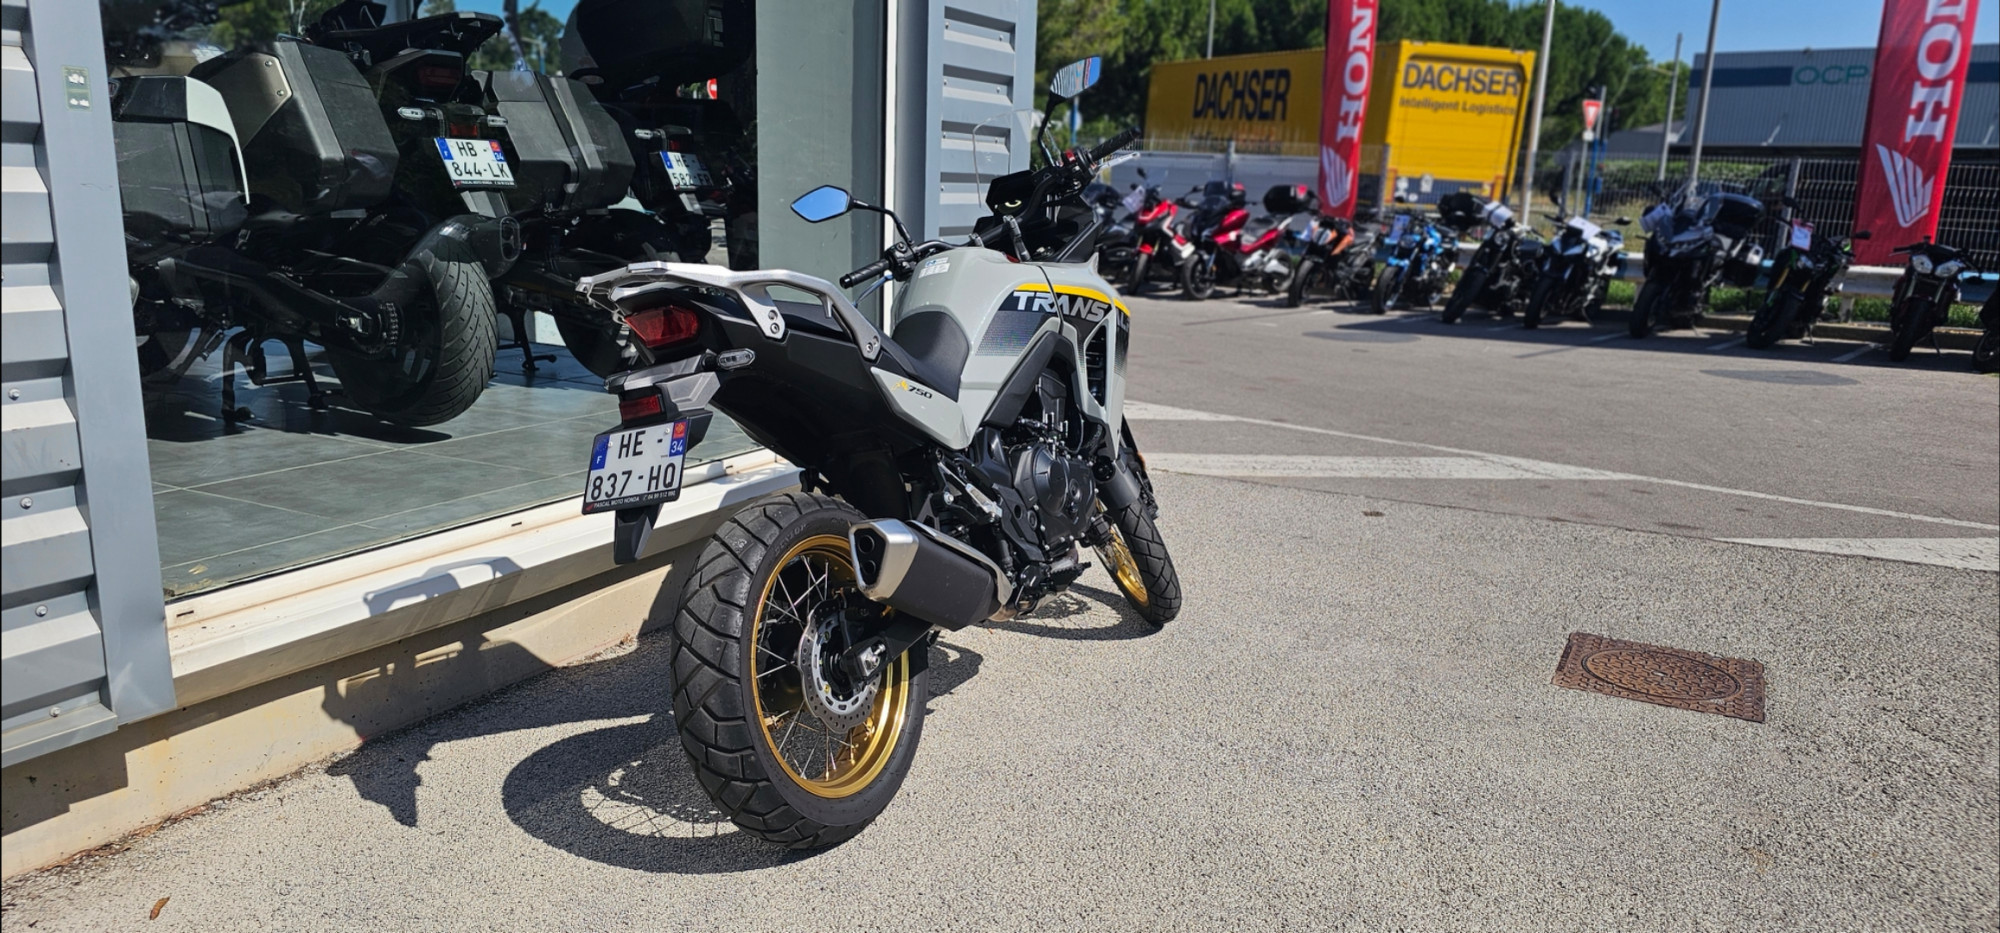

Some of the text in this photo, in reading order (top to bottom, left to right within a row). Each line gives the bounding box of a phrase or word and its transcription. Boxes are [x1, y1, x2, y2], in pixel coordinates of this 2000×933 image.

[1402, 62, 1520, 97] DACHSER
[1795, 64, 1869, 85] OCP
[1193, 67, 1291, 122] DACHSER
[1400, 96, 1516, 115] Intelligent Logistics
[456, 141, 477, 157] HB
[618, 430, 646, 459] HE
[671, 439, 683, 453] 34
[596, 455, 602, 464] F
